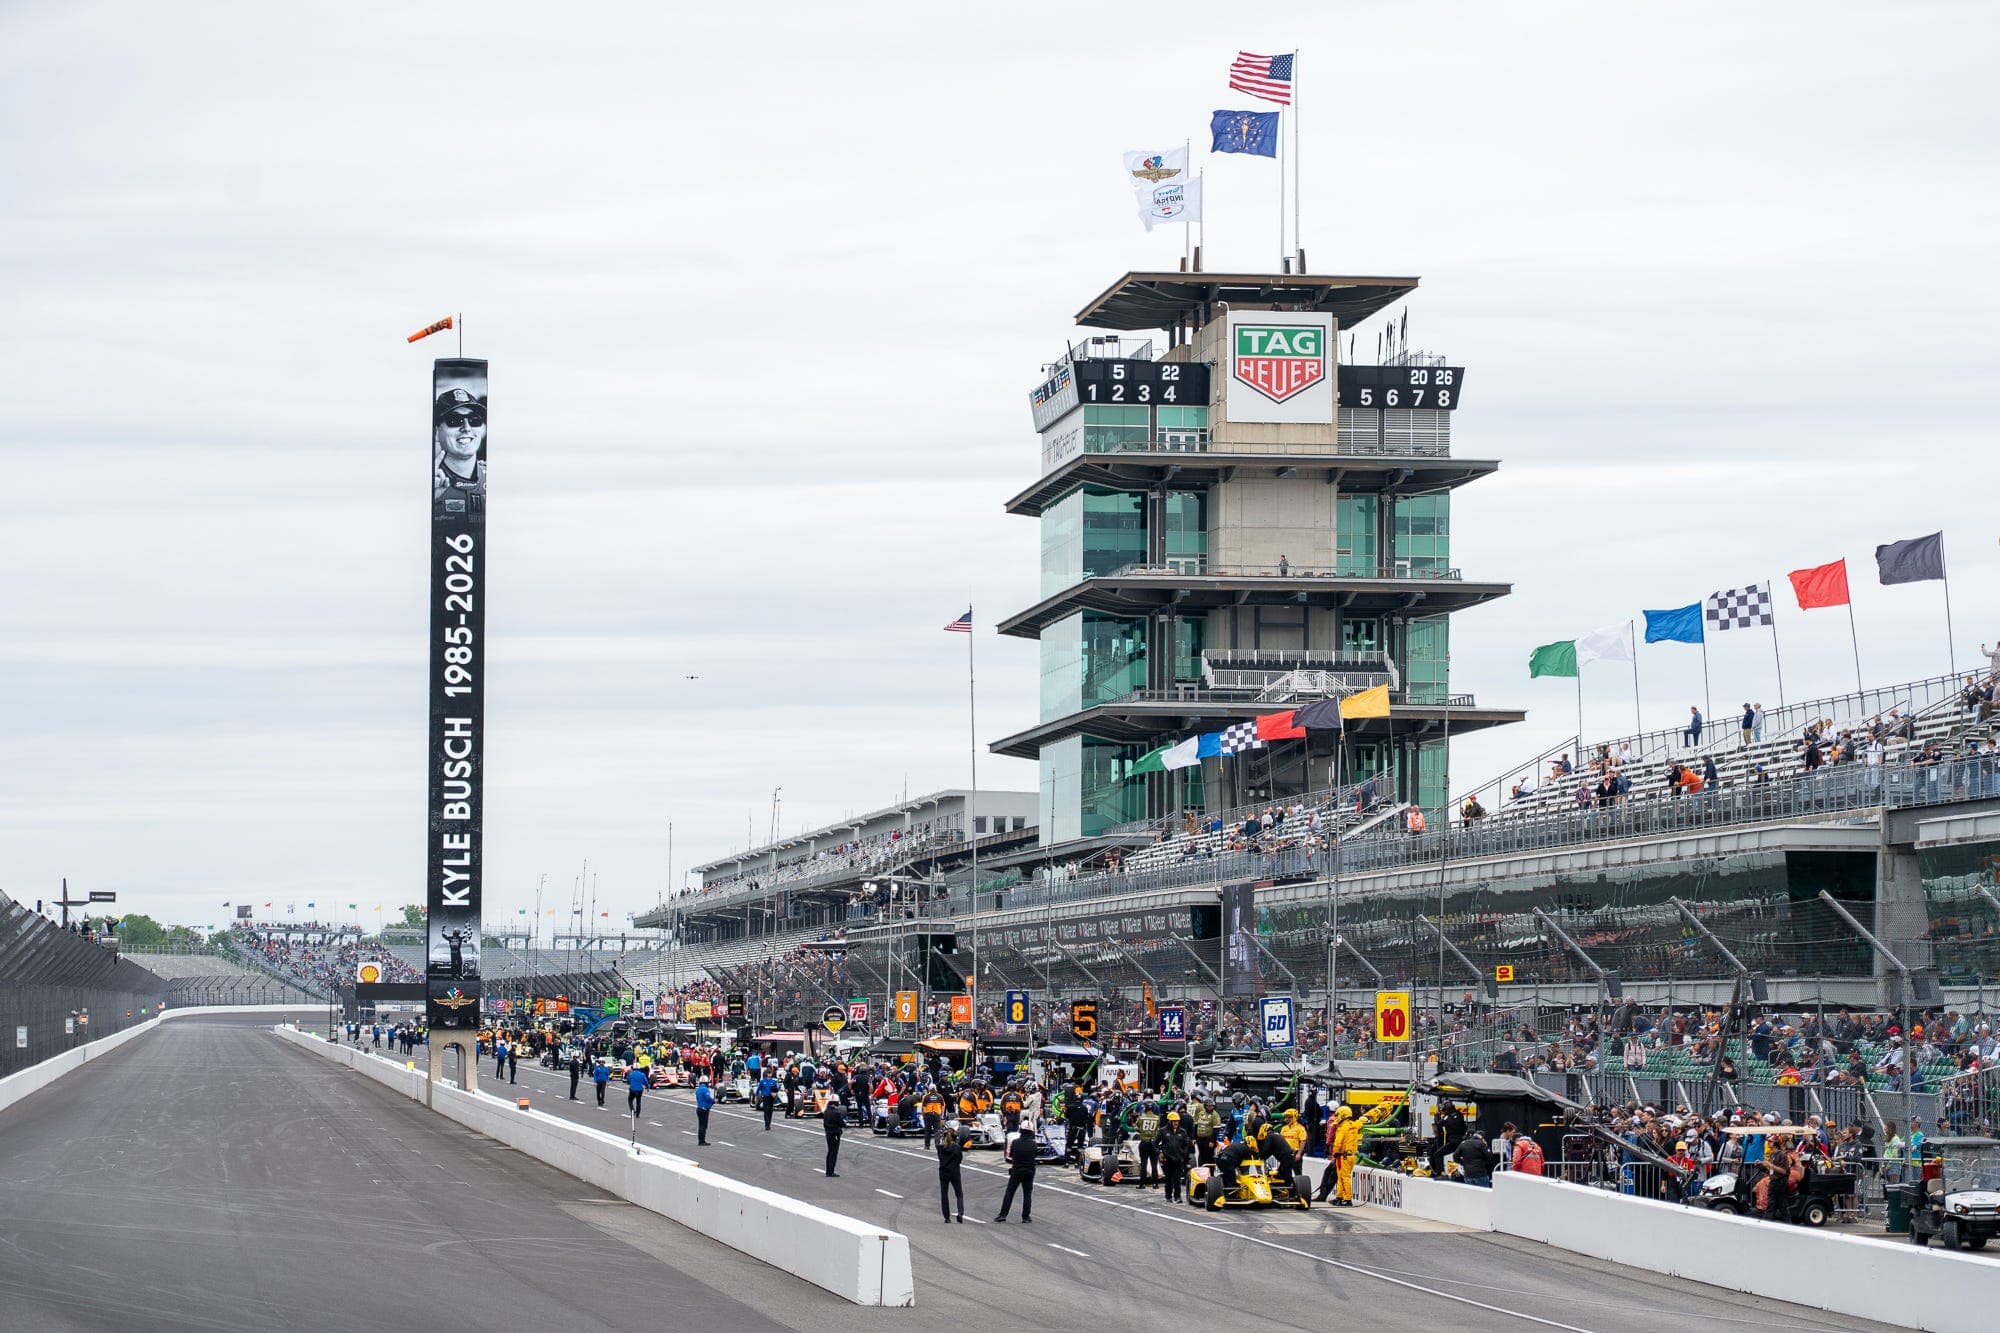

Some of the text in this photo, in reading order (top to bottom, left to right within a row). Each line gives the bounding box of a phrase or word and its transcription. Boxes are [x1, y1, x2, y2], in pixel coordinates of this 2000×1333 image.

[424, 319, 449, 335] IMS
[1243, 331, 1316, 354] TAG
[1113, 365, 1180, 381] 5 22
[1240, 360, 1319, 395] HEUER
[1411, 370, 1453, 385] 20 26
[1088, 384, 1177, 402] 1 2 3 4
[1360, 389, 1450, 407] 5 6 7 8
[444, 533, 474, 698] 1985-2026
[443, 717, 473, 821] BUSCH
[442, 833, 471, 906] KYLE
[851, 1006, 866, 1019] 75
[901, 1002, 911, 1019] 9
[1011, 1001, 1024, 1022] 8
[1073, 1005, 1096, 1037] 5
[1163, 1015, 1181, 1032] 14
[1267, 1014, 1287, 1031] 60
[1380, 1008, 1406, 1037] 10
[1142, 1119, 1157, 1131] 60
